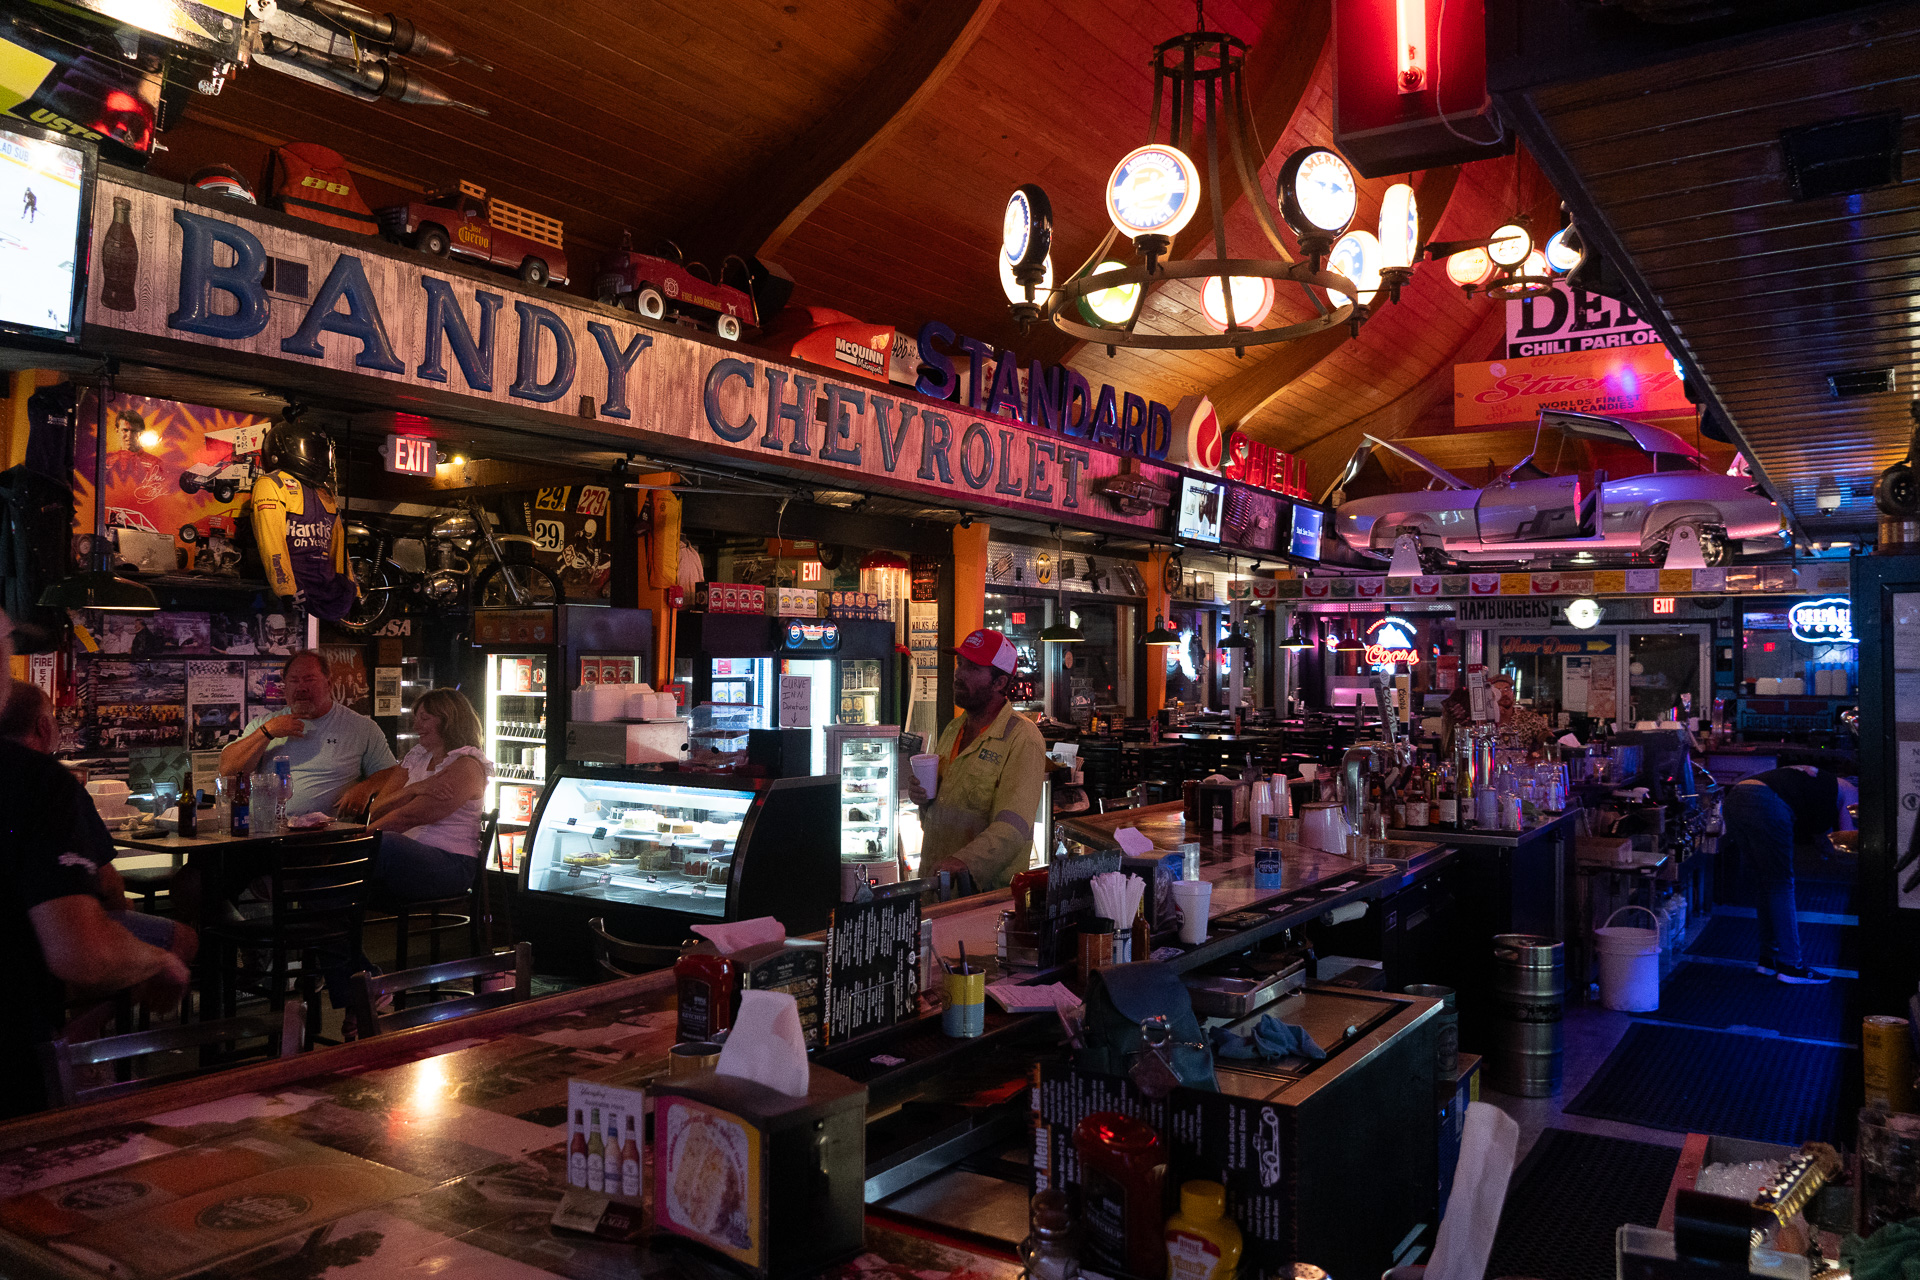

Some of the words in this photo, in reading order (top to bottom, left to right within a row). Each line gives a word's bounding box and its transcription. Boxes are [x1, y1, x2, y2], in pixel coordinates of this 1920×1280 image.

[1300, 153, 1354, 194] AMERICAN
[301, 176, 349, 196] 88
[458, 226, 489, 249] Cuervo
[681, 291, 693, 302] FIRE
[704, 297, 723, 312] RESCUE
[168, 208, 654, 421] BANDY
[835, 337, 884, 366] McQUINN
[1519, 342, 1571, 357] CHILI
[1580, 330, 1663, 351] PARLOR
[915, 320, 1172, 463] STANDARD
[1538, 398, 1592, 410] WORLDS
[1594, 393, 1641, 405] FINEST
[1580, 401, 1635, 413] CANDIES
[704, 358, 1089, 509] CHEVROLET
[395, 438, 431, 473] EXIT
[1226, 432, 1312, 500] SHELL
[577, 489, 606, 515] 279
[293, 538, 308, 547] Oh
[536, 523, 559, 549] 29
[802, 562, 822, 581] EXIT
[1460, 600, 1549, 620] HAMBURGERS
[1653, 598, 1675, 614] EXIT
[33, 657, 53, 667] FIRE
[1365, 644, 1420, 665] Coors
[781, 677, 809, 688] CURVE
[782, 691, 804, 700] INN
[782, 701, 808, 711] Donations
[826, 926, 834, 974] Cocktails
[824, 976, 832, 1022] Specialty
[1033, 1127, 1048, 1168] Menu
[1229, 1143, 1235, 1152] us
[601, 1213, 630, 1229] LAGER
